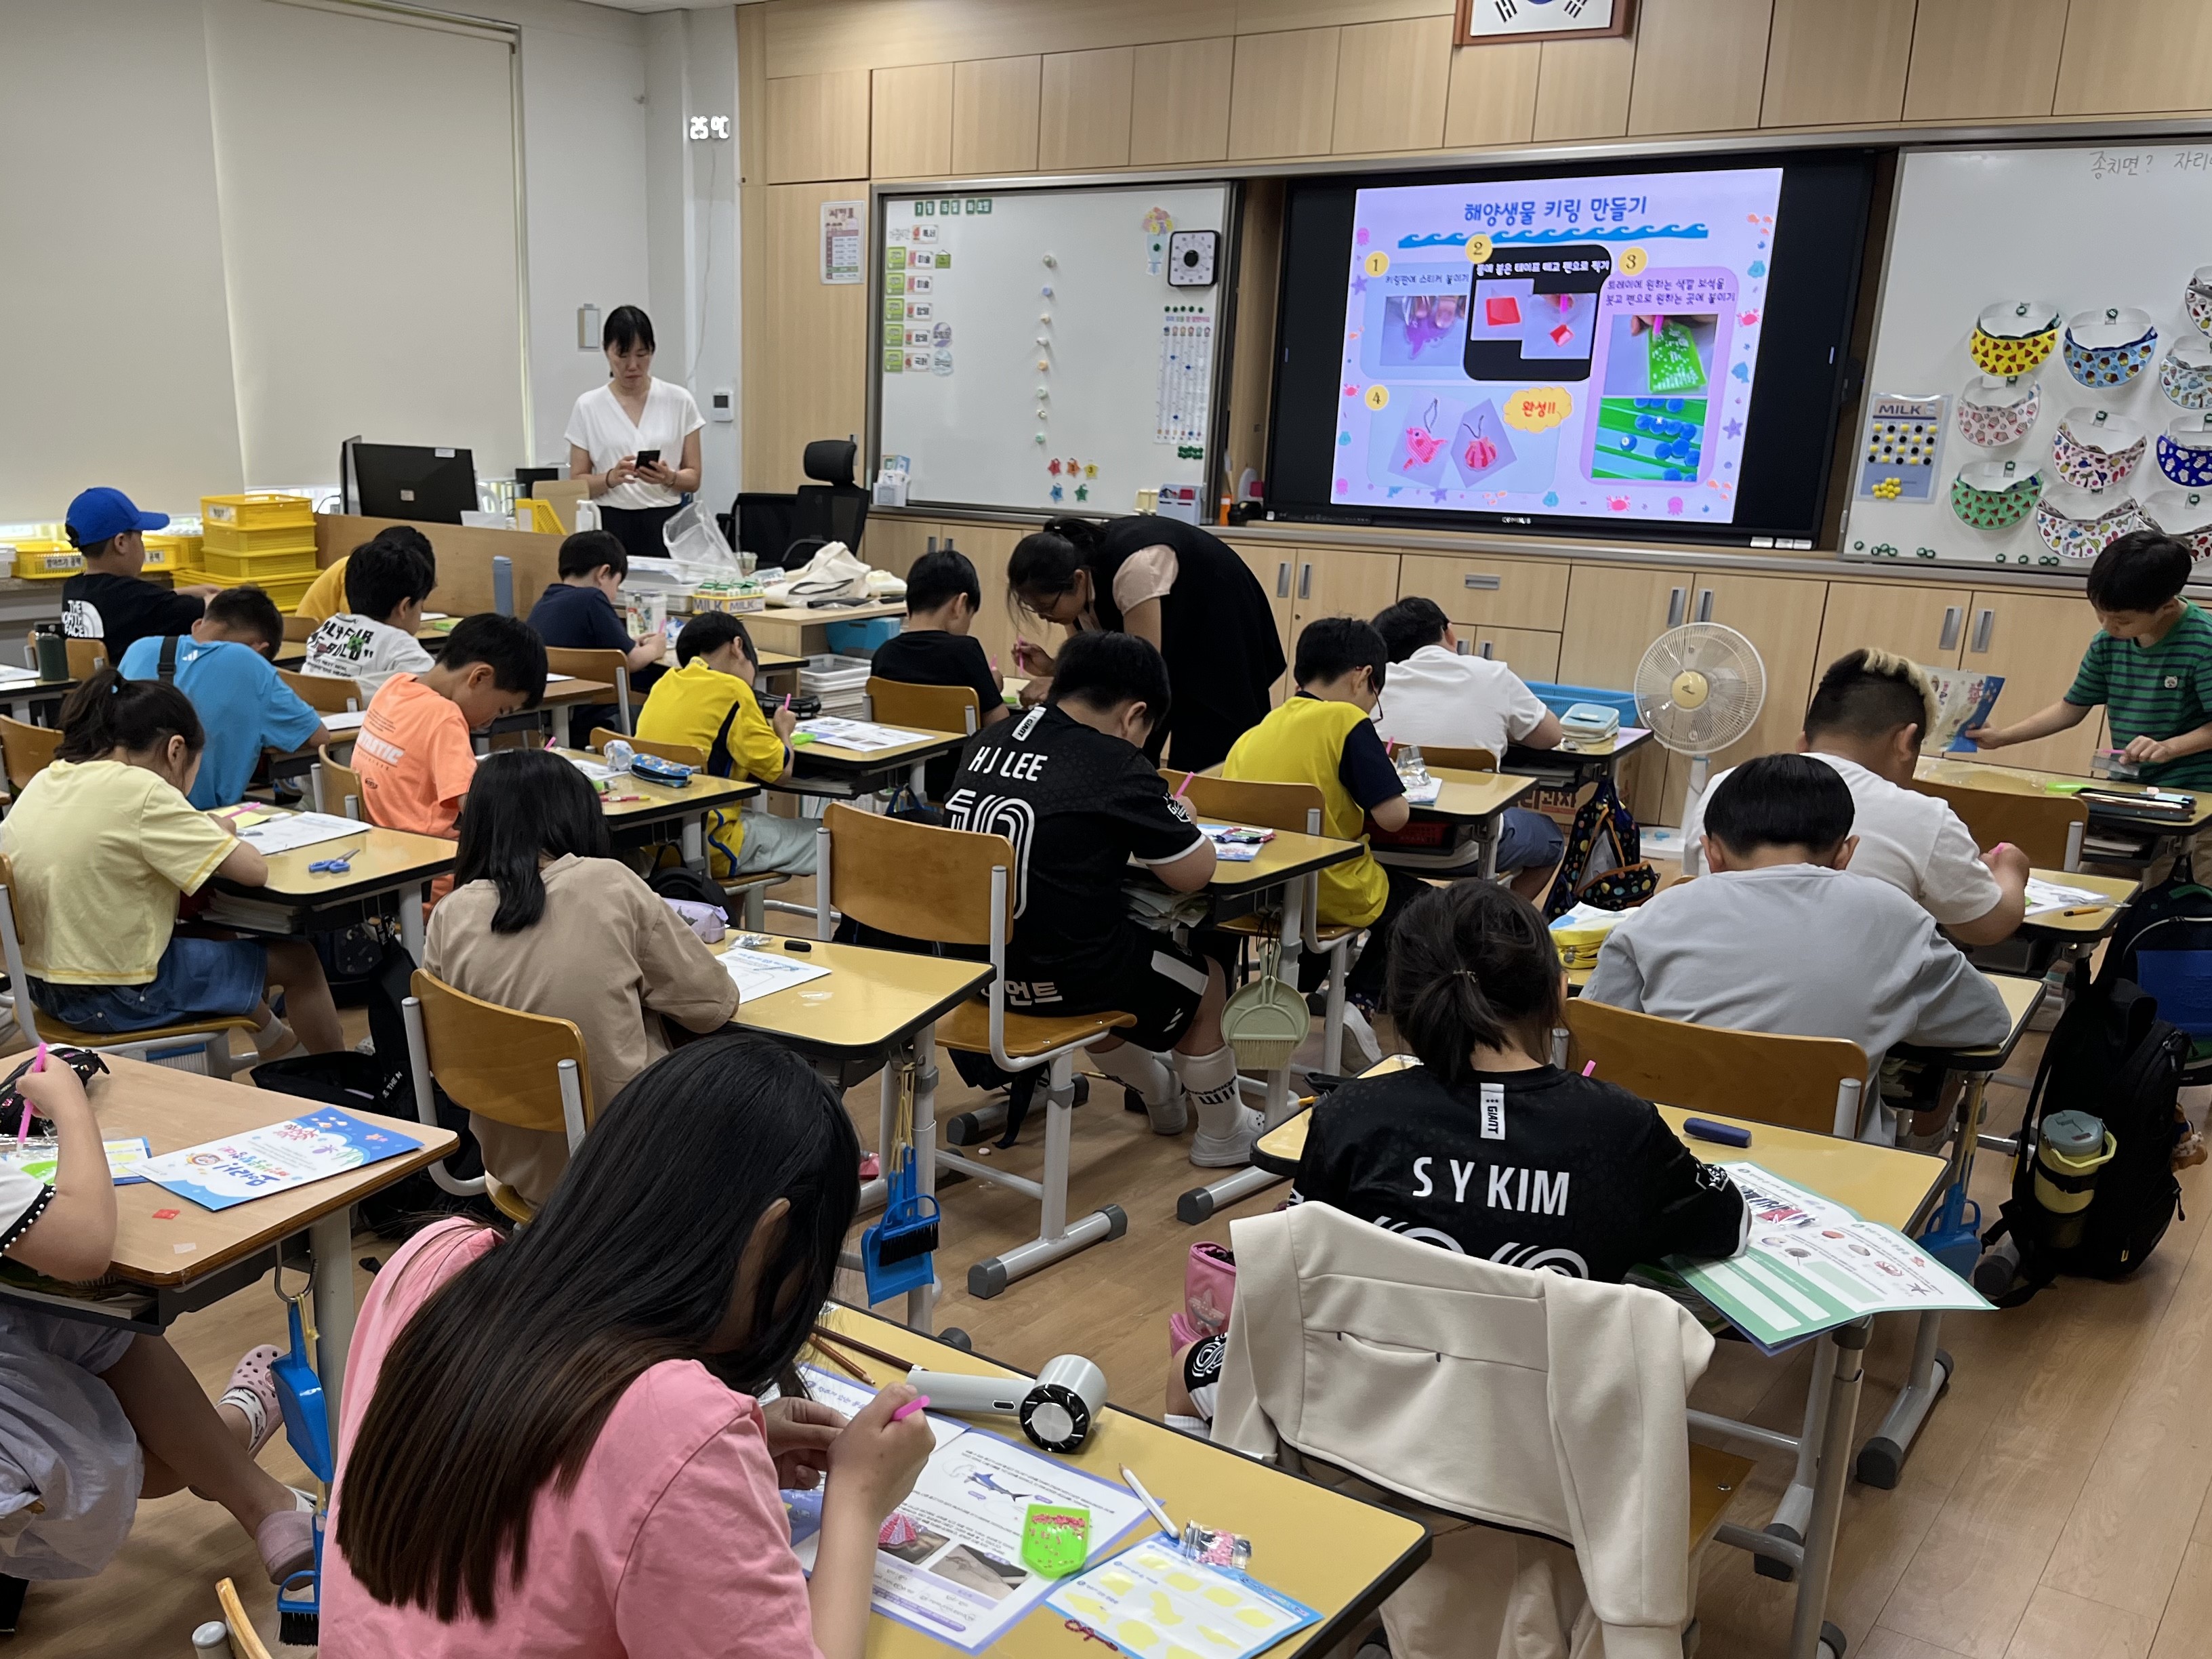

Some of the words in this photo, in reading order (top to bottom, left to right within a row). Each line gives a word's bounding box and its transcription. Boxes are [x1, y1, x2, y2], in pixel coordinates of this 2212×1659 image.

[1464, 201, 1535, 226] 해양생물
[1544, 199, 1581, 224] 키링
[1591, 196, 1647, 222] 만들기
[1473, 241, 1482, 255] 2
[1372, 258, 1379, 272] 1
[1626, 254, 1637, 270] 3
[1372, 390, 1382, 405] 4
[1521, 401, 1557, 417] 완성!!
[1879, 405, 1922, 415] MILK
[68, 600, 81, 613] THE
[729, 599, 754, 611] MILK
[62, 611, 81, 625] ORTH
[1000, 751, 1048, 781] LEE
[1412, 1156, 1433, 1197] S
[1449, 1159, 1475, 1203] Y
[1487, 1164, 1570, 1216] KIM
